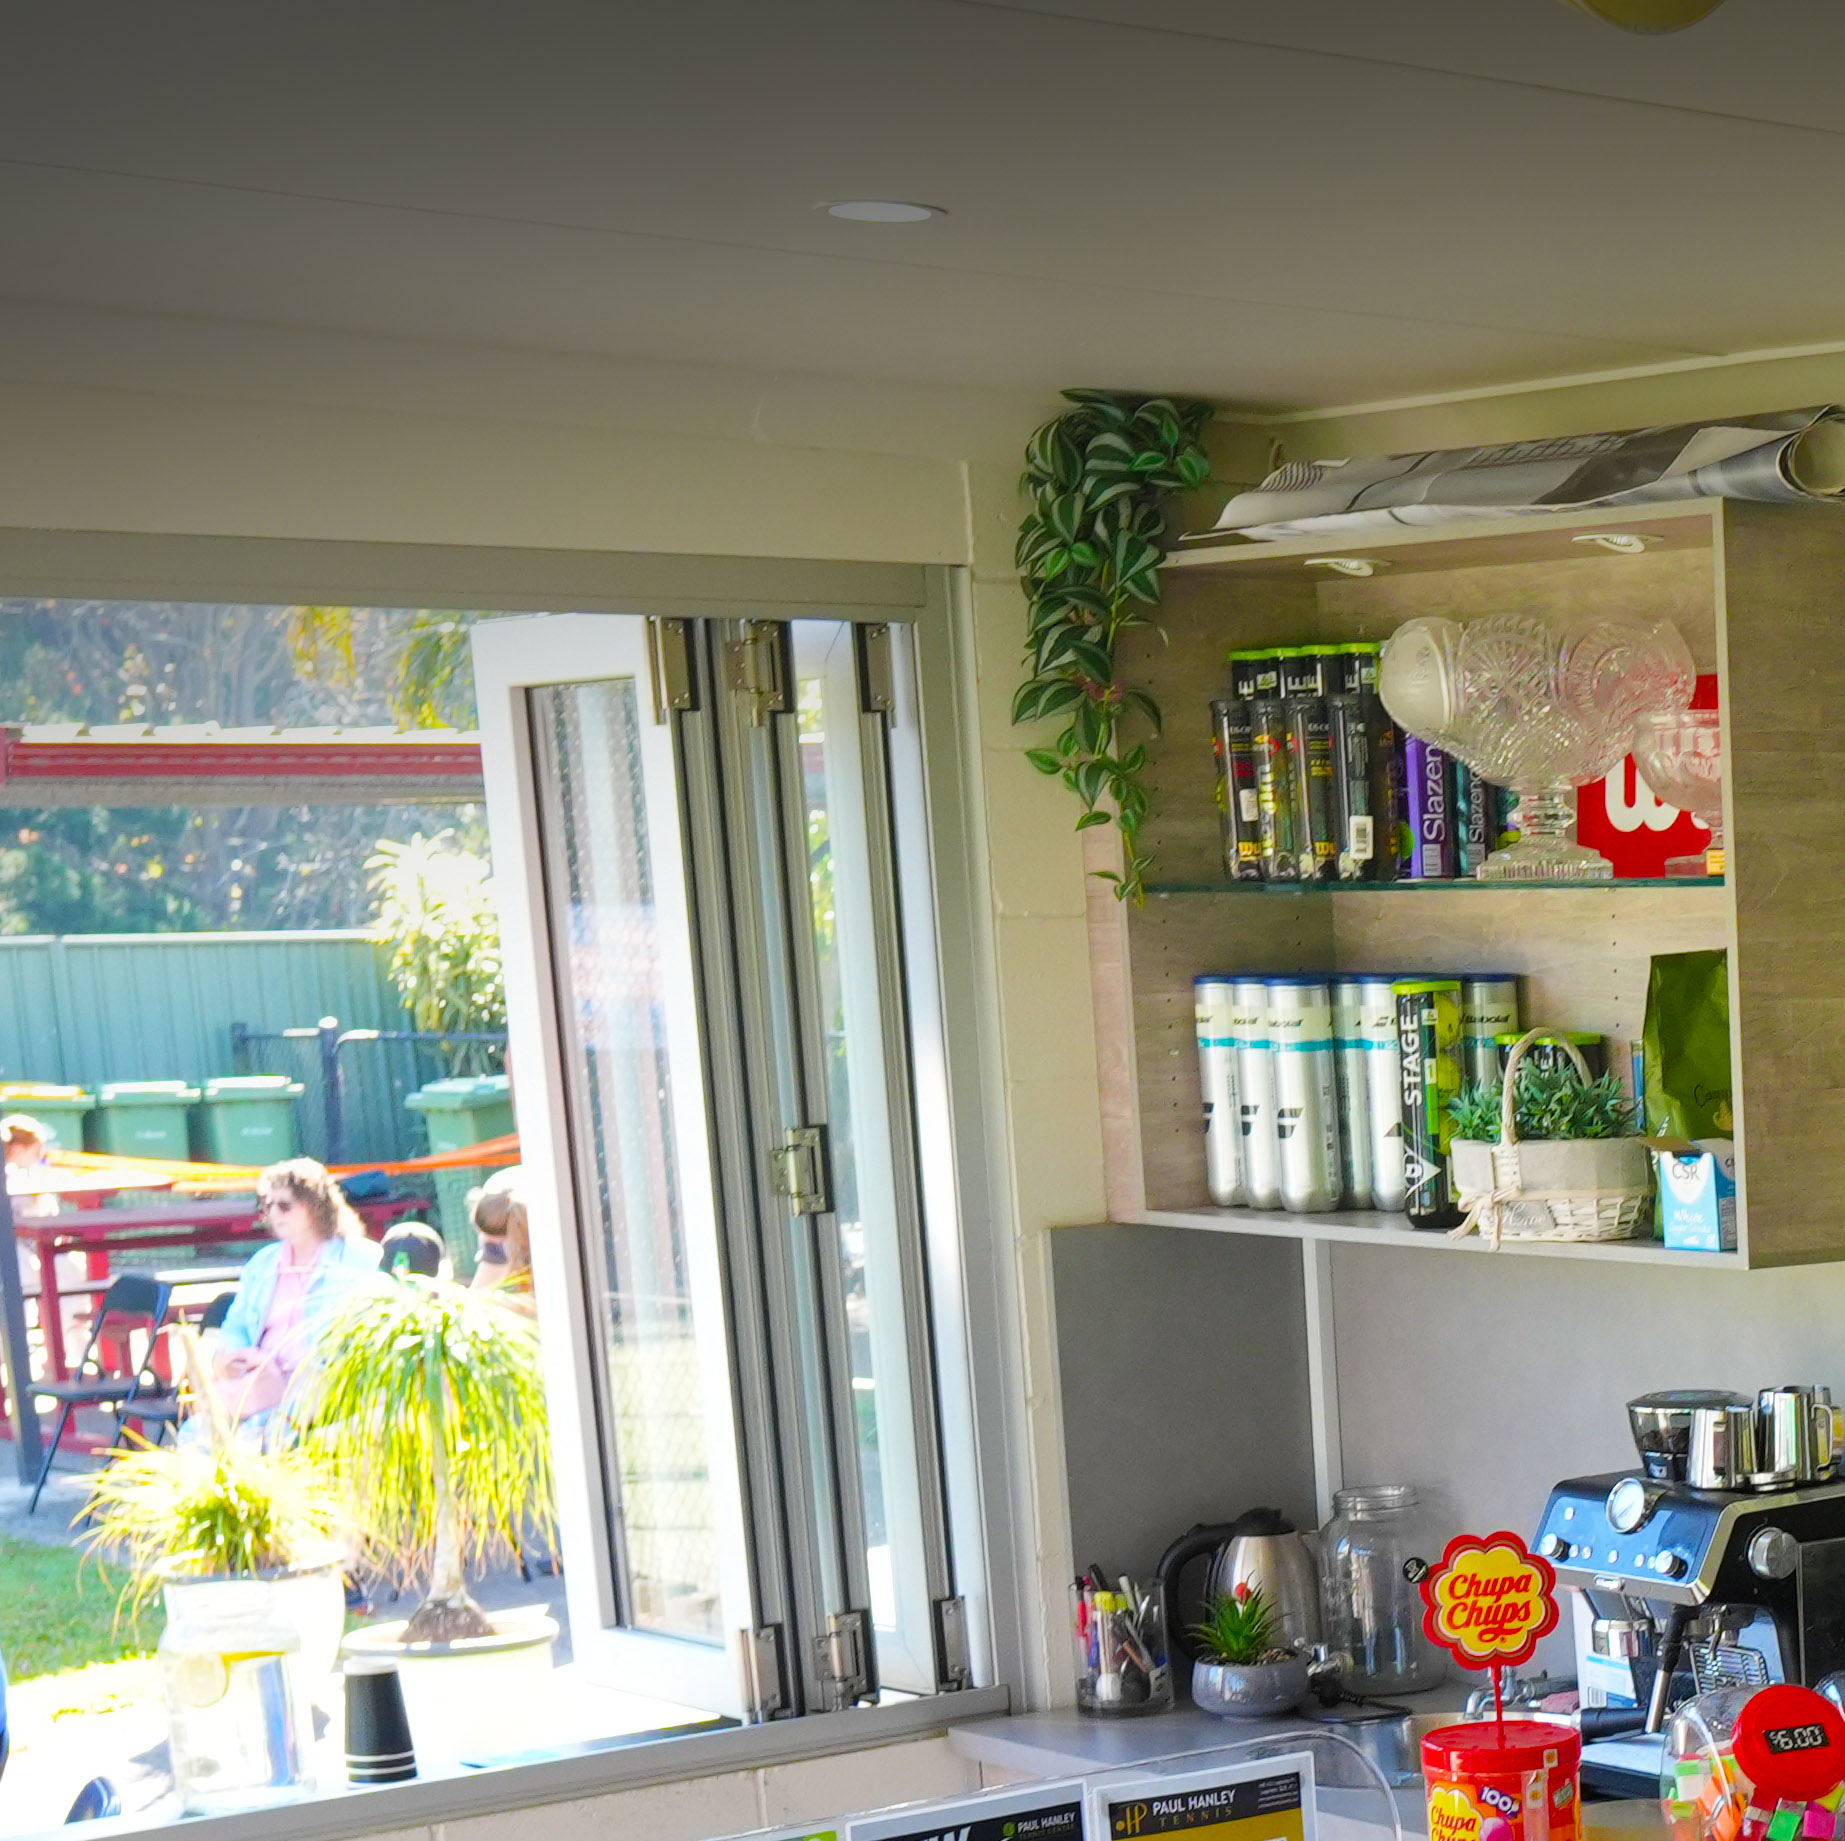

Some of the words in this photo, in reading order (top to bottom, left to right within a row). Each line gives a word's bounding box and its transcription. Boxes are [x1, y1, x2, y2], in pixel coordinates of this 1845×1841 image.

[1403, 999, 1422, 1106] STAGE
[1671, 1162, 1701, 1182] CSR
[1447, 1574, 1532, 1598] Chupa
[1446, 1598, 1532, 1643] Chups
[1769, 1725, 1823, 1750] $6.00
[1152, 1800, 1186, 1816] PAUL
[1188, 1789, 1236, 1810] HANLEY
[1018, 1819, 1039, 1833] PAUL
[1041, 1812, 1075, 1830] HANLEY
[1159, 1806, 1232, 1827] TENNIS
[1429, 1806, 1477, 1834] Chupa
